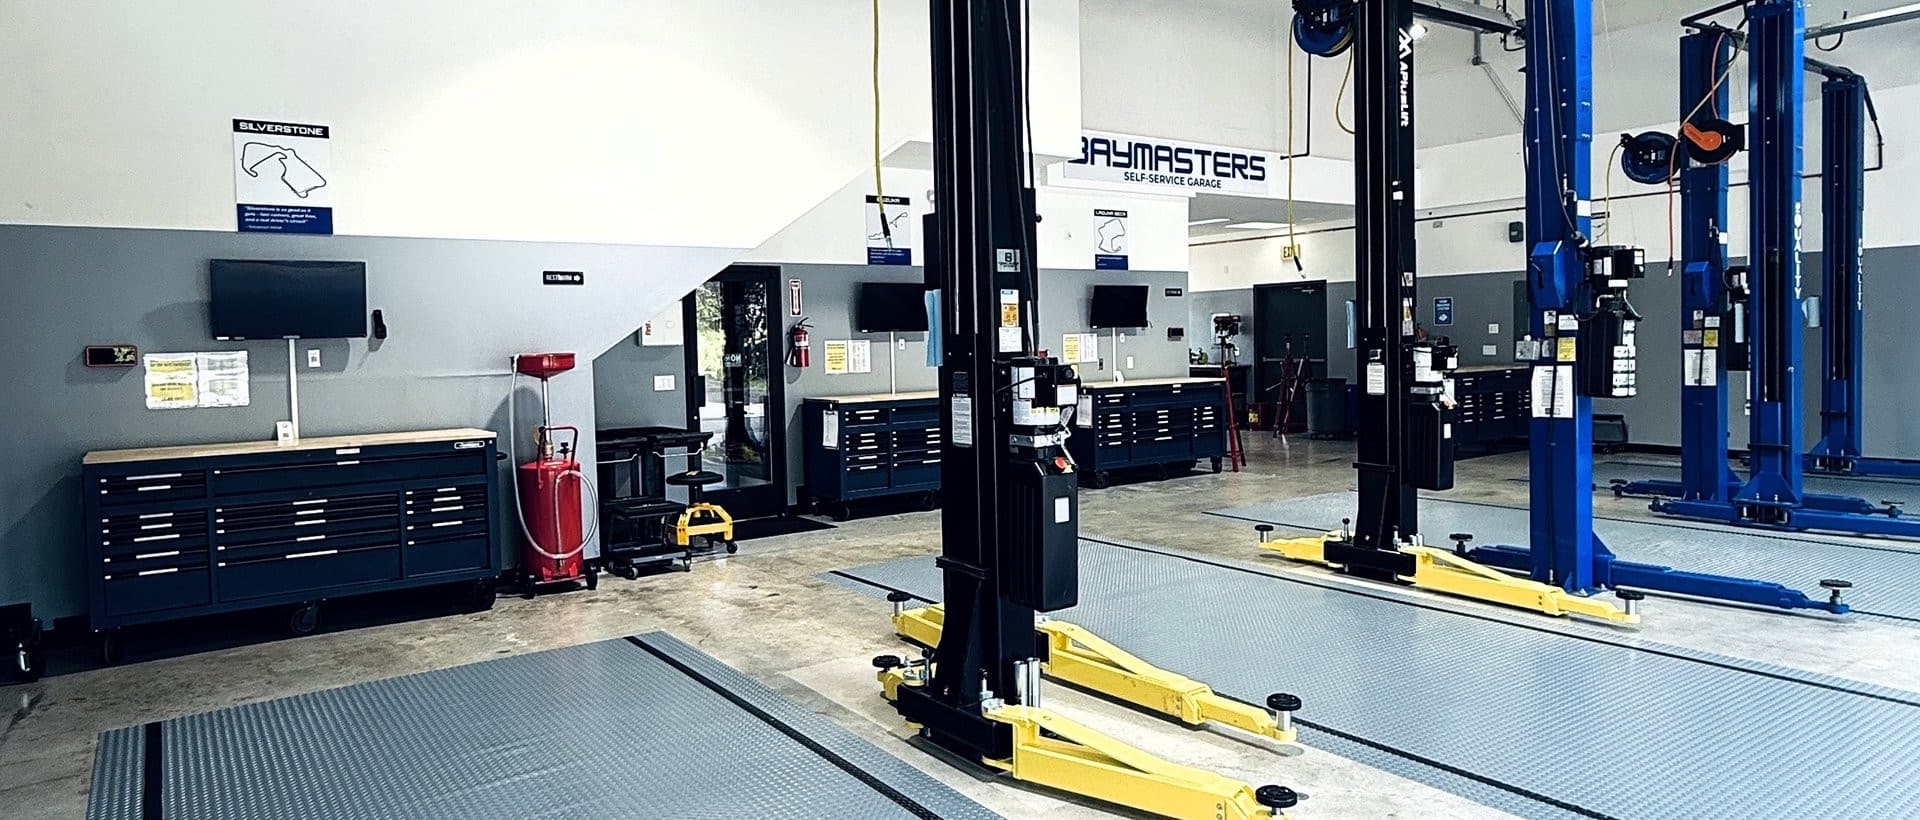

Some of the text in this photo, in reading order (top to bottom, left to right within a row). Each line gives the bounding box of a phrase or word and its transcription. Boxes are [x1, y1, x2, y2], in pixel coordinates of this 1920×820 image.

[239, 121, 324, 136] SILVERSTONE
[1068, 136, 1265, 181] BAYMASTERS
[1124, 171, 1222, 189] SELF-SERVICE GARAGE
